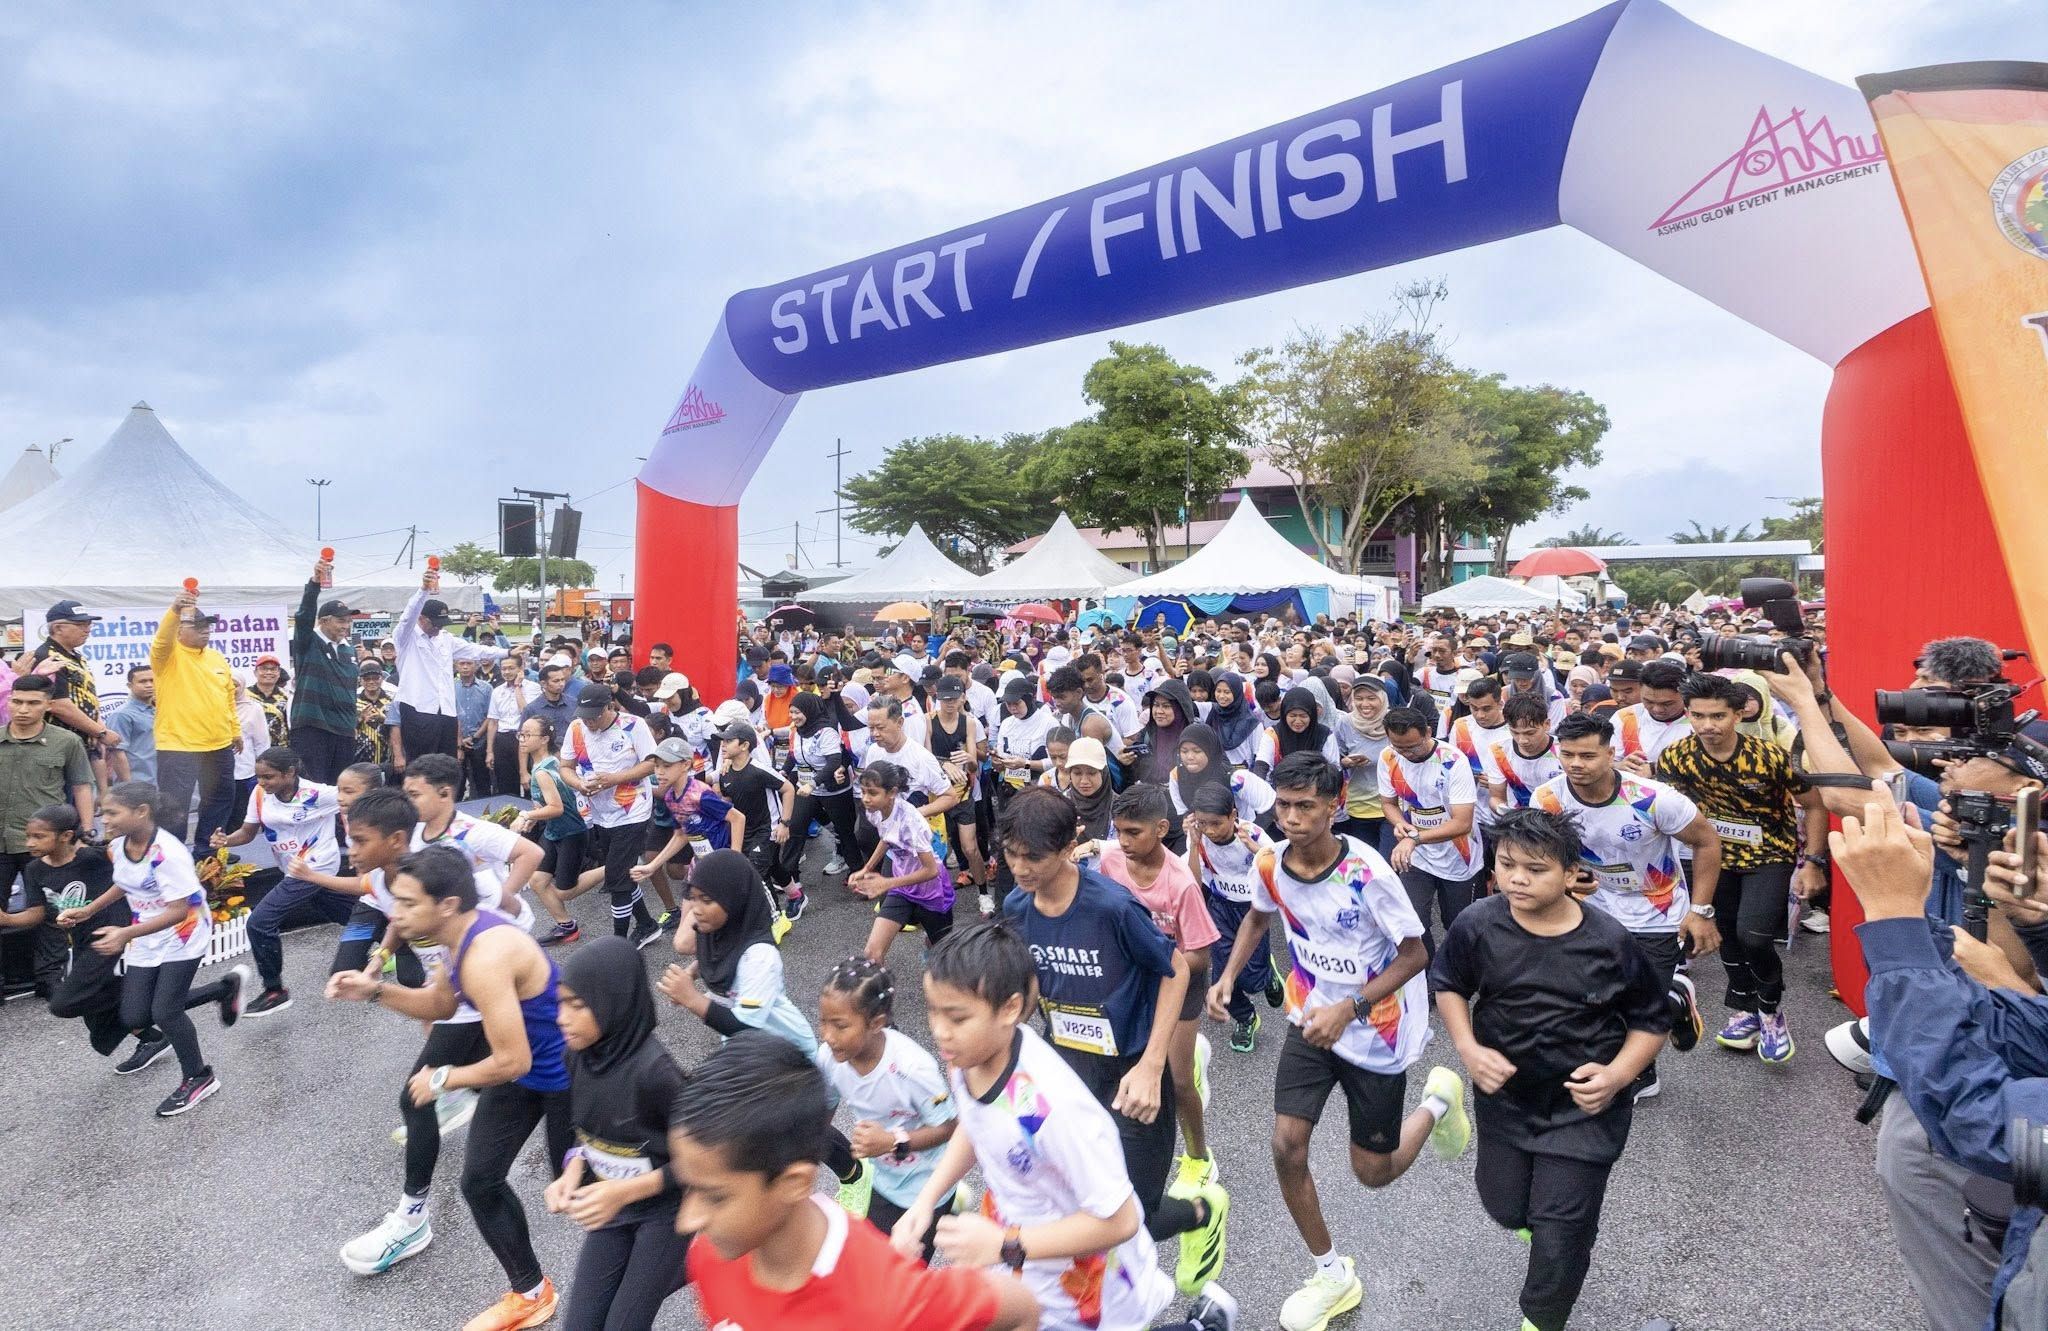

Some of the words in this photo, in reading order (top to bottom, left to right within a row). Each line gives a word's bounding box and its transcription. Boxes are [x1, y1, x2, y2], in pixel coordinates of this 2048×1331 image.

[1657, 216, 1698, 237] ASHKHU
[1701, 204, 1734, 223] GLOW
[1738, 190, 1779, 212] EVENT
[1784, 163, 1881, 197] MANAGEMENT
[771, 233, 987, 355] START
[1013, 206, 1068, 299] /
[1090, 79, 1468, 277] FINISH
[91, 616, 158, 638] arian
[353, 621, 392, 629] KEROPOK
[82, 642, 151, 661] SULTAN
[231, 637, 275, 653] SHAH
[104, 663, 124, 676] 23
[1417, 817, 1443, 826] V8007
[1716, 824, 1752, 838] V8131
[1046, 945, 1100, 965] SMART
[1298, 944, 1357, 976] M4830
[1063, 1020, 1104, 1040] V8256
